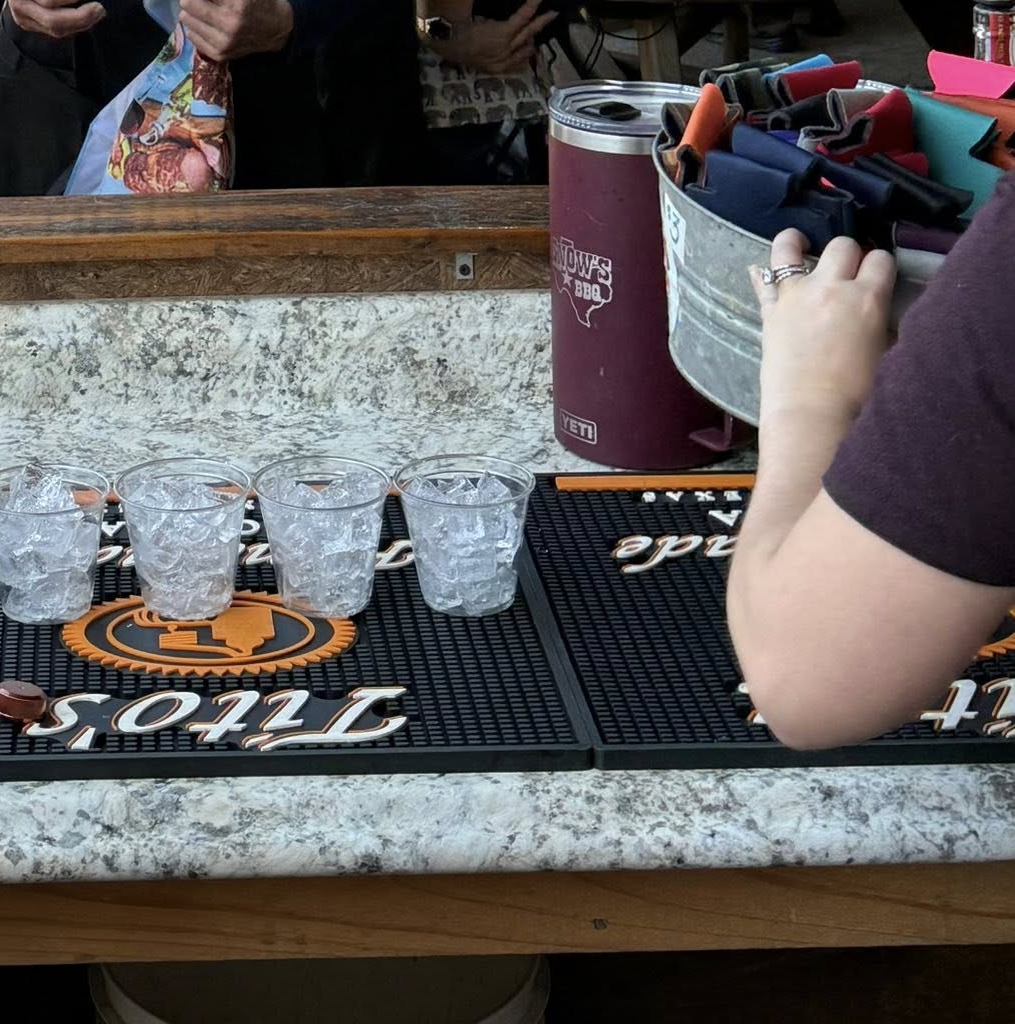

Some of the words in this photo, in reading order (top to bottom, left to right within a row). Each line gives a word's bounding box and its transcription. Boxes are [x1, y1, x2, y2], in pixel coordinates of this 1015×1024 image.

[575, 279, 602, 302] BBQ
[562, 413, 592, 439] YETI
[21, 685, 408, 751] Tito's
